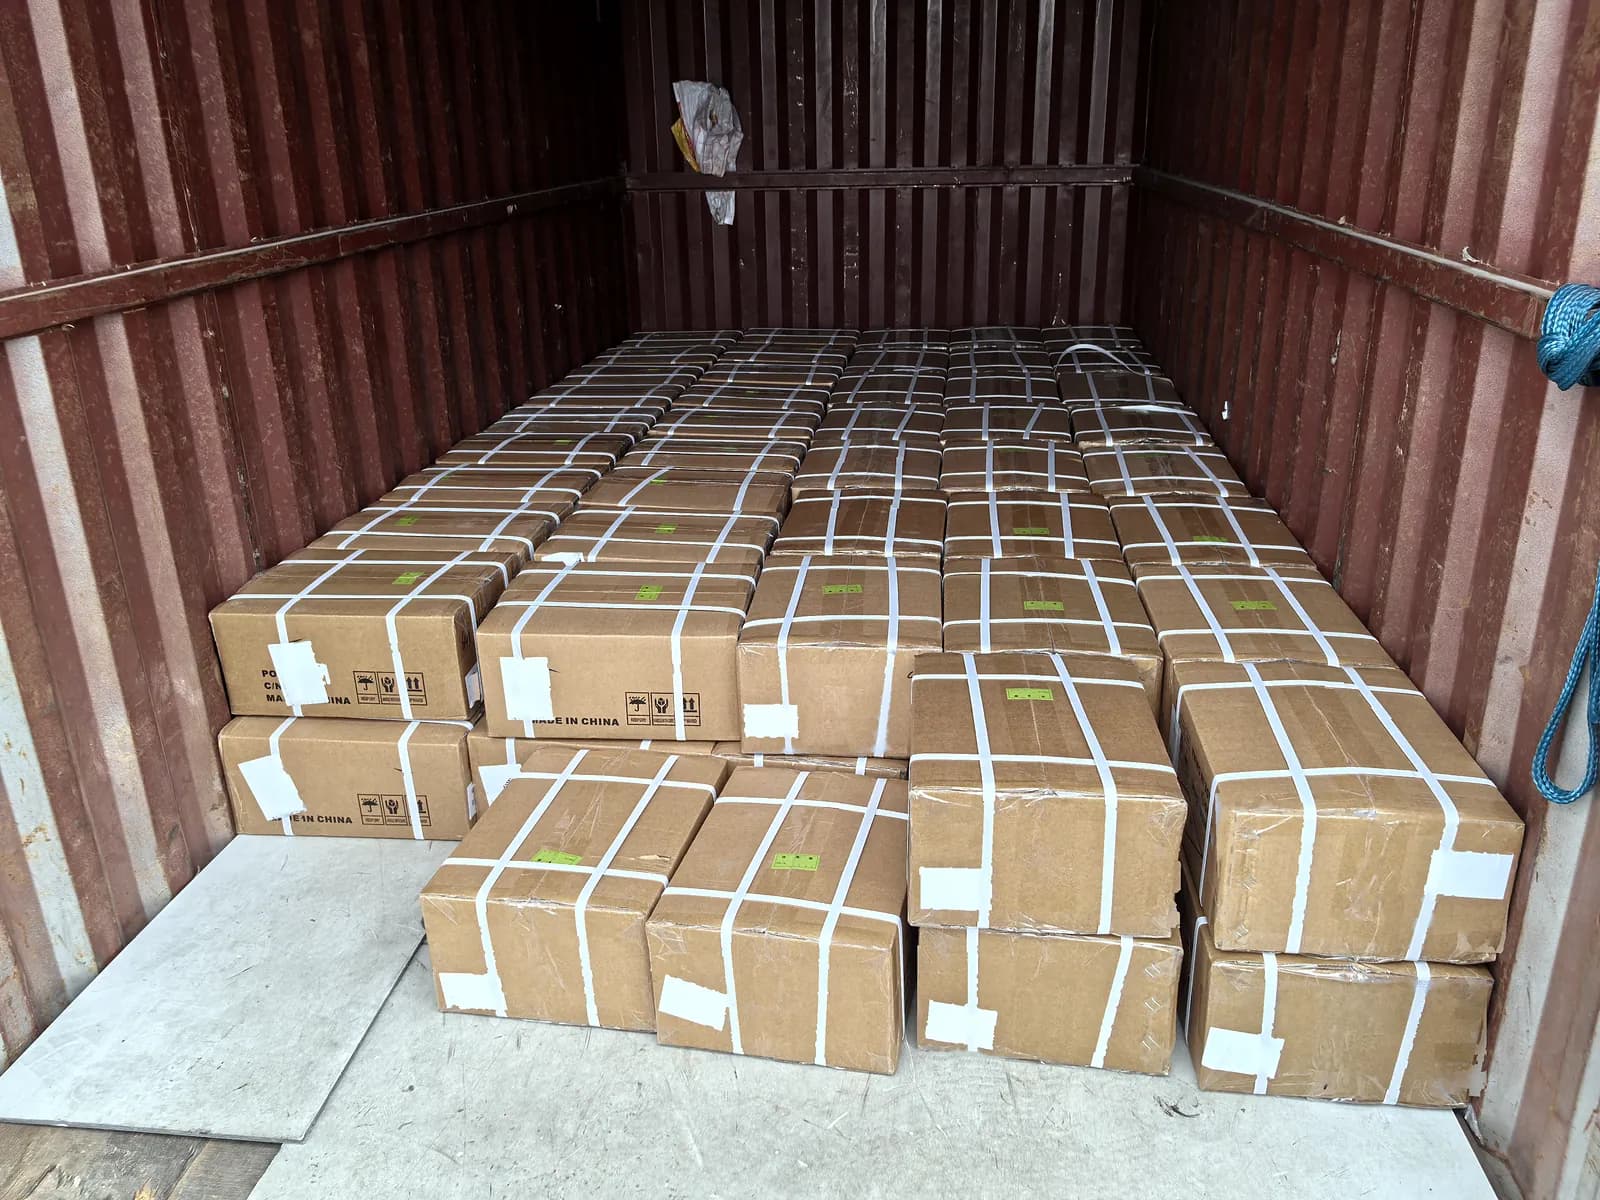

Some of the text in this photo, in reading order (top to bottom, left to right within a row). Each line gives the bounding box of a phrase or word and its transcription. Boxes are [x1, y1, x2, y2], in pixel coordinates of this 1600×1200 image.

[261, 669, 277, 678] PO
[327, 696, 351, 705] INA
[565, 717, 579, 725] IN
[581, 718, 620, 726] CHINA
[317, 815, 353, 824] CHINA
